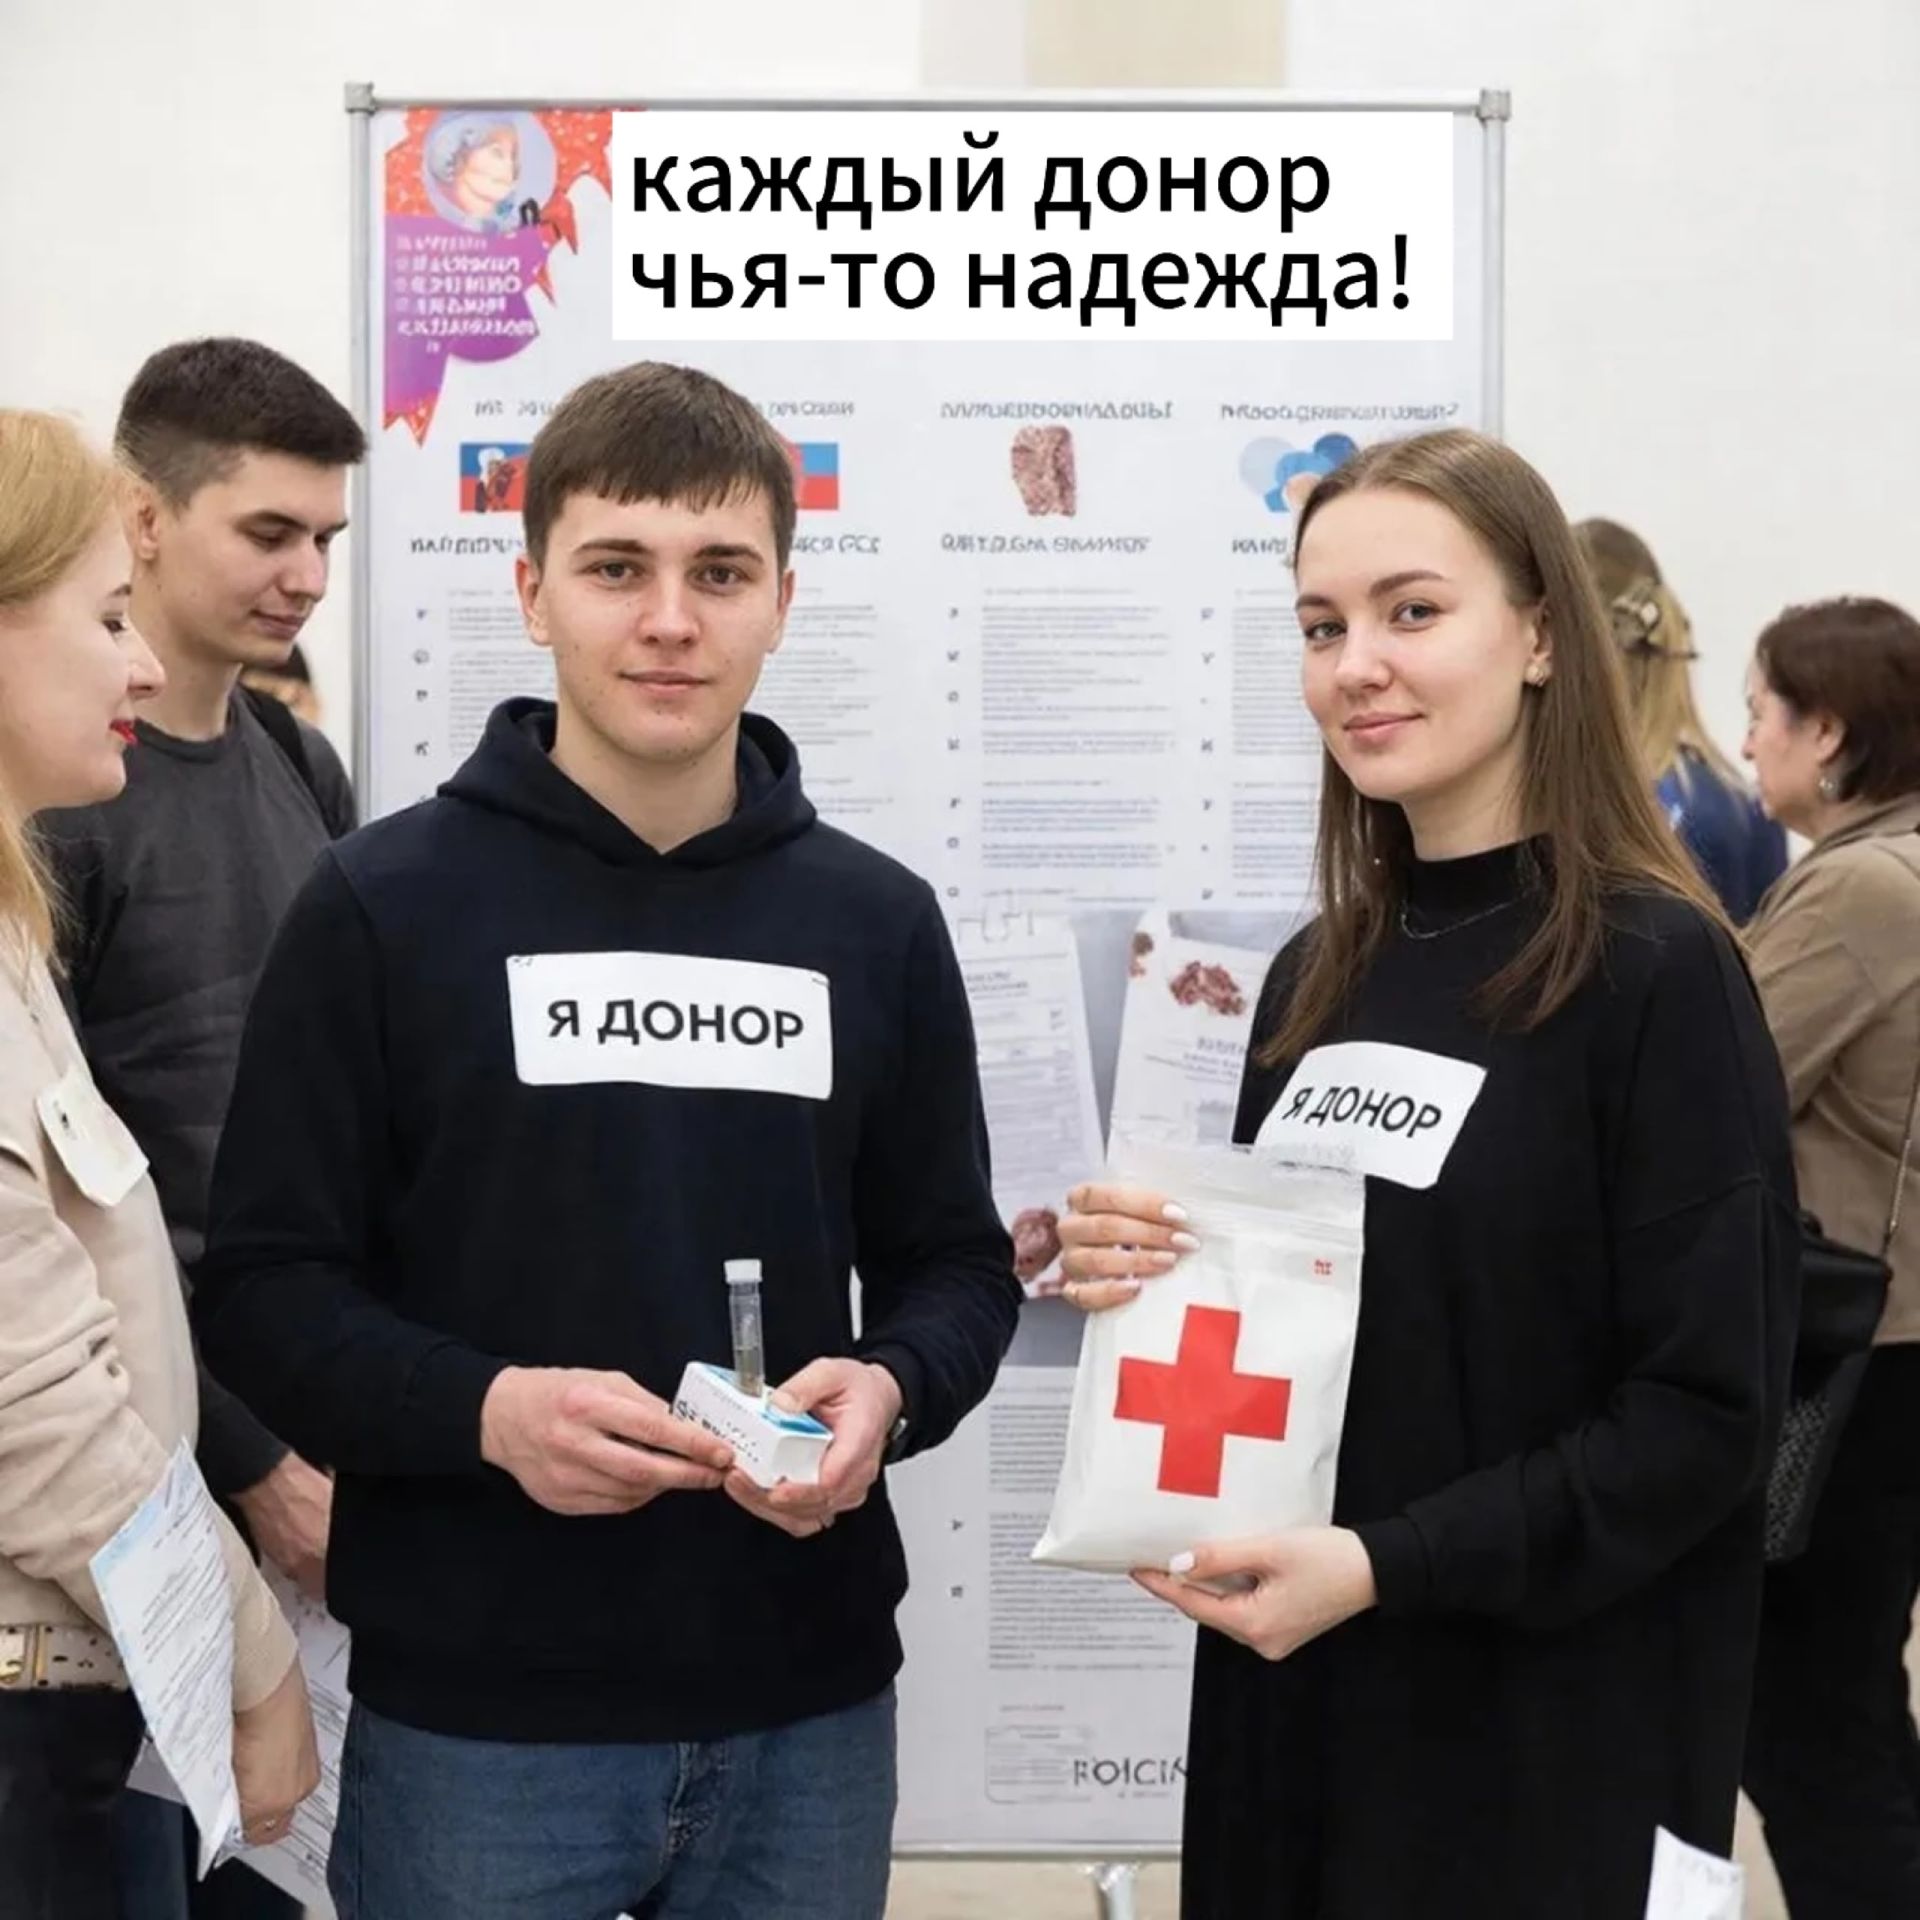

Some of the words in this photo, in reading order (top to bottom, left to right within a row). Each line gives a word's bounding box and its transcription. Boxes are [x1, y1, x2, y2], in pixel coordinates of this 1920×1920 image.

[548, 1000, 580, 1037] Я
[597, 999, 804, 1049] ДОНОР
[1282, 1086, 1314, 1120] Я
[1304, 1086, 1442, 1138] ДОНОР
